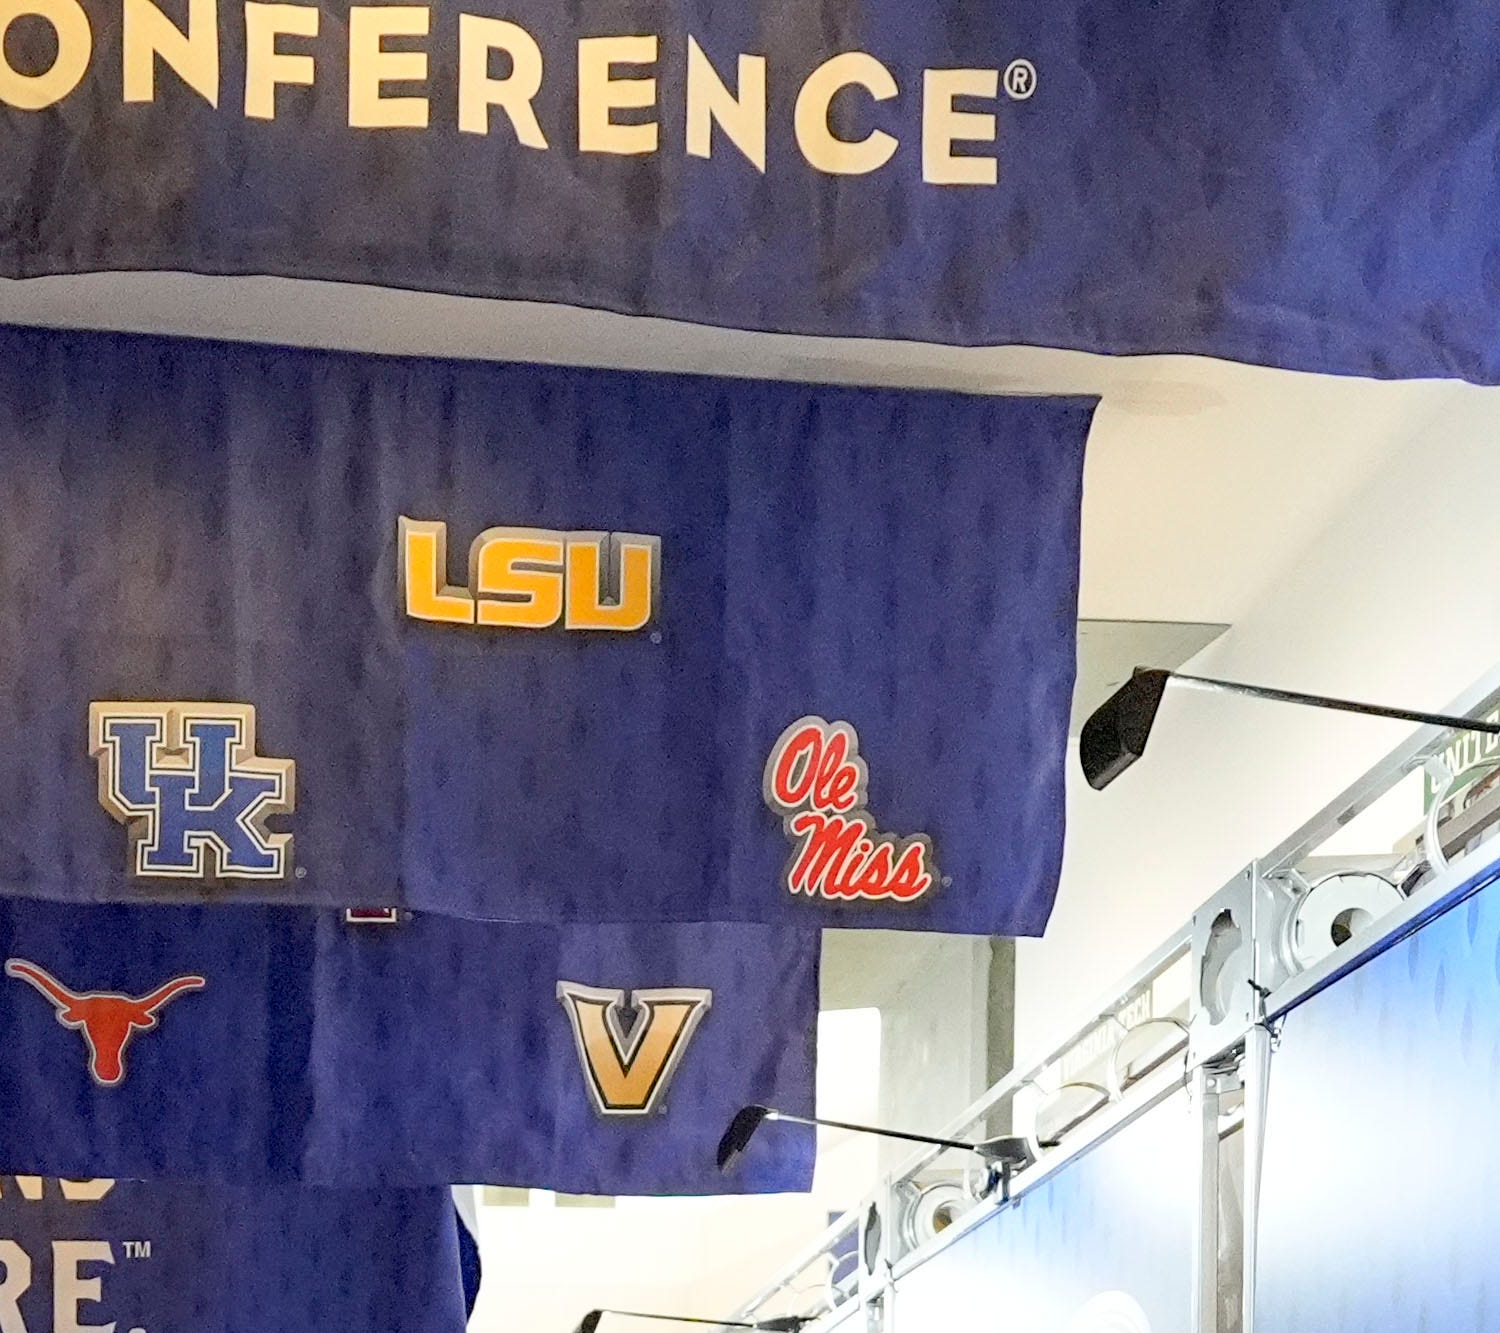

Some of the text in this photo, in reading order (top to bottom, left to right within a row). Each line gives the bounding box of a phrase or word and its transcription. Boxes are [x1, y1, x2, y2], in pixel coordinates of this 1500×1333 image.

[401, 519, 660, 630] LSU
[772, 724, 858, 814] Ole
[789, 812, 932, 902] Miss
